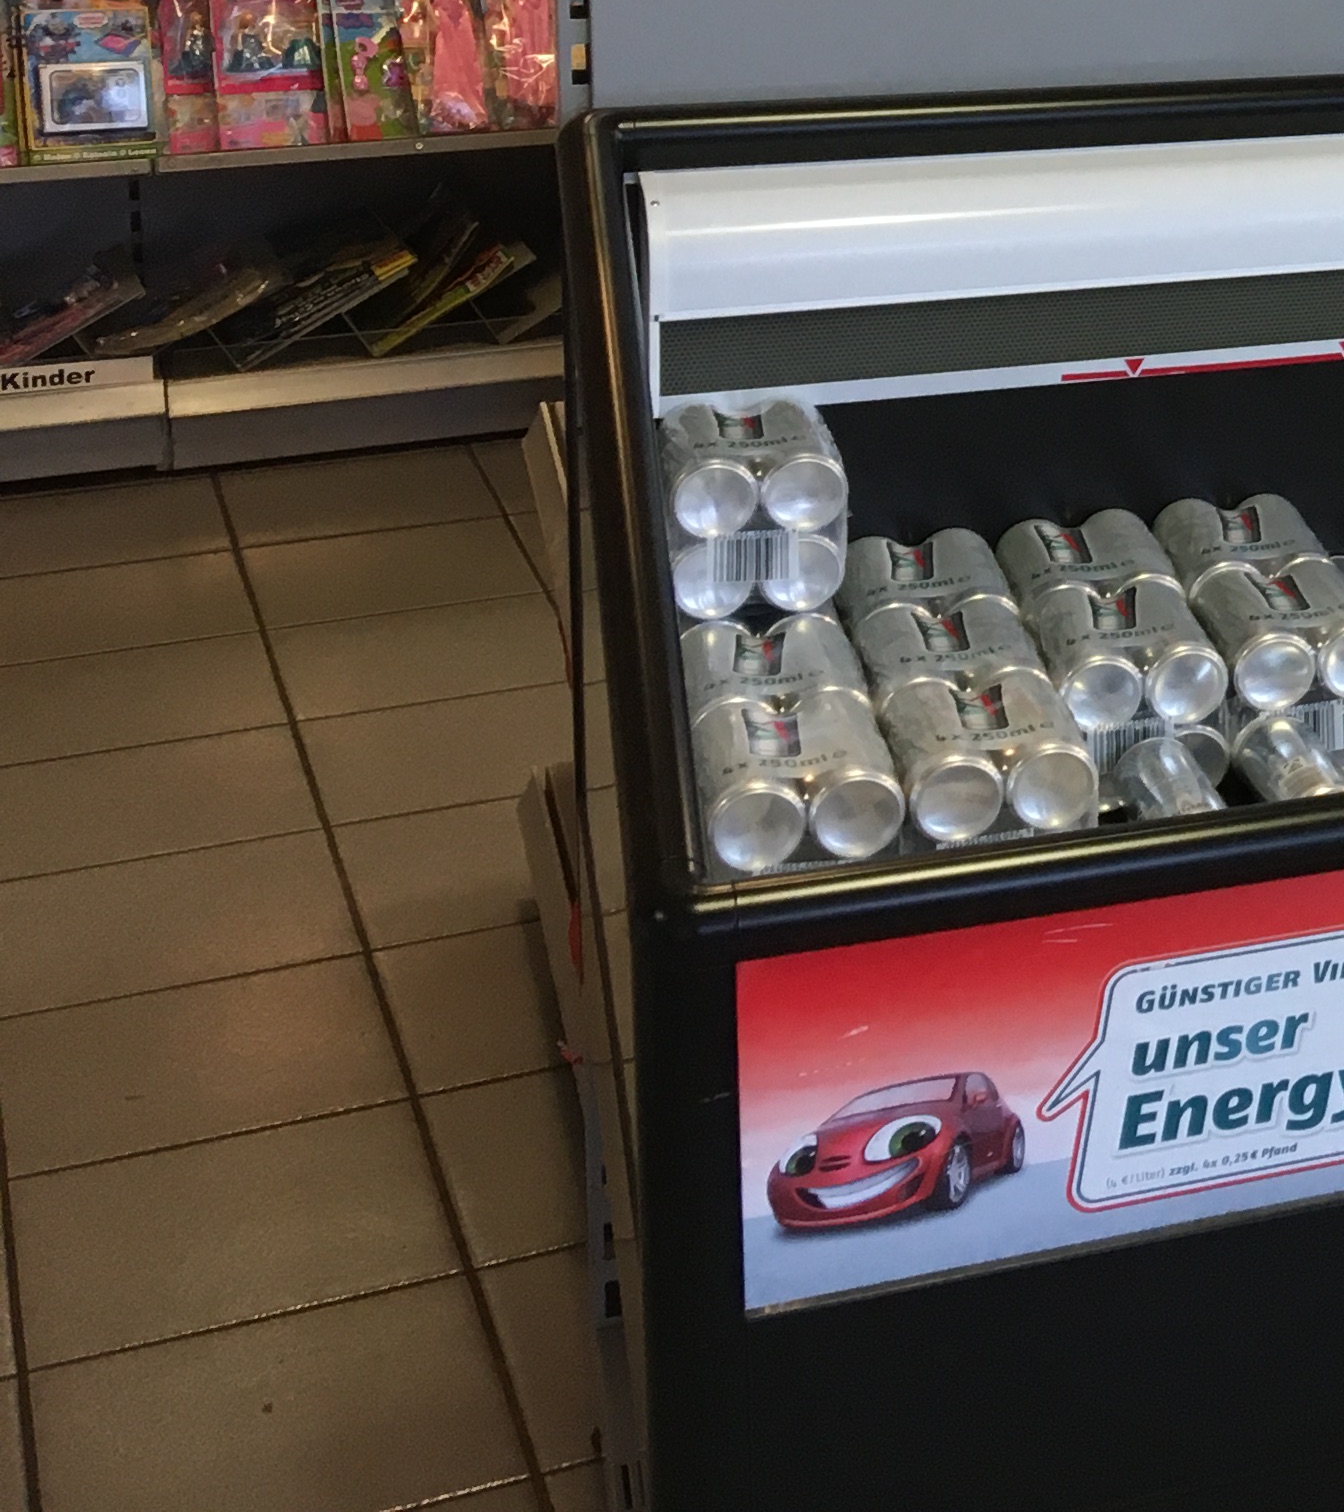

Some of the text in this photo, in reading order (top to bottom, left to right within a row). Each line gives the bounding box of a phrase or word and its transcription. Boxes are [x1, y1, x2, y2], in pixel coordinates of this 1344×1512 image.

[0, 368, 96, 390] Kinder
[1135, 969, 1301, 1014] GÜNSTIGER
[1131, 1010, 1309, 1076] unser
[1261, 1143, 1298, 1158] Pfand
